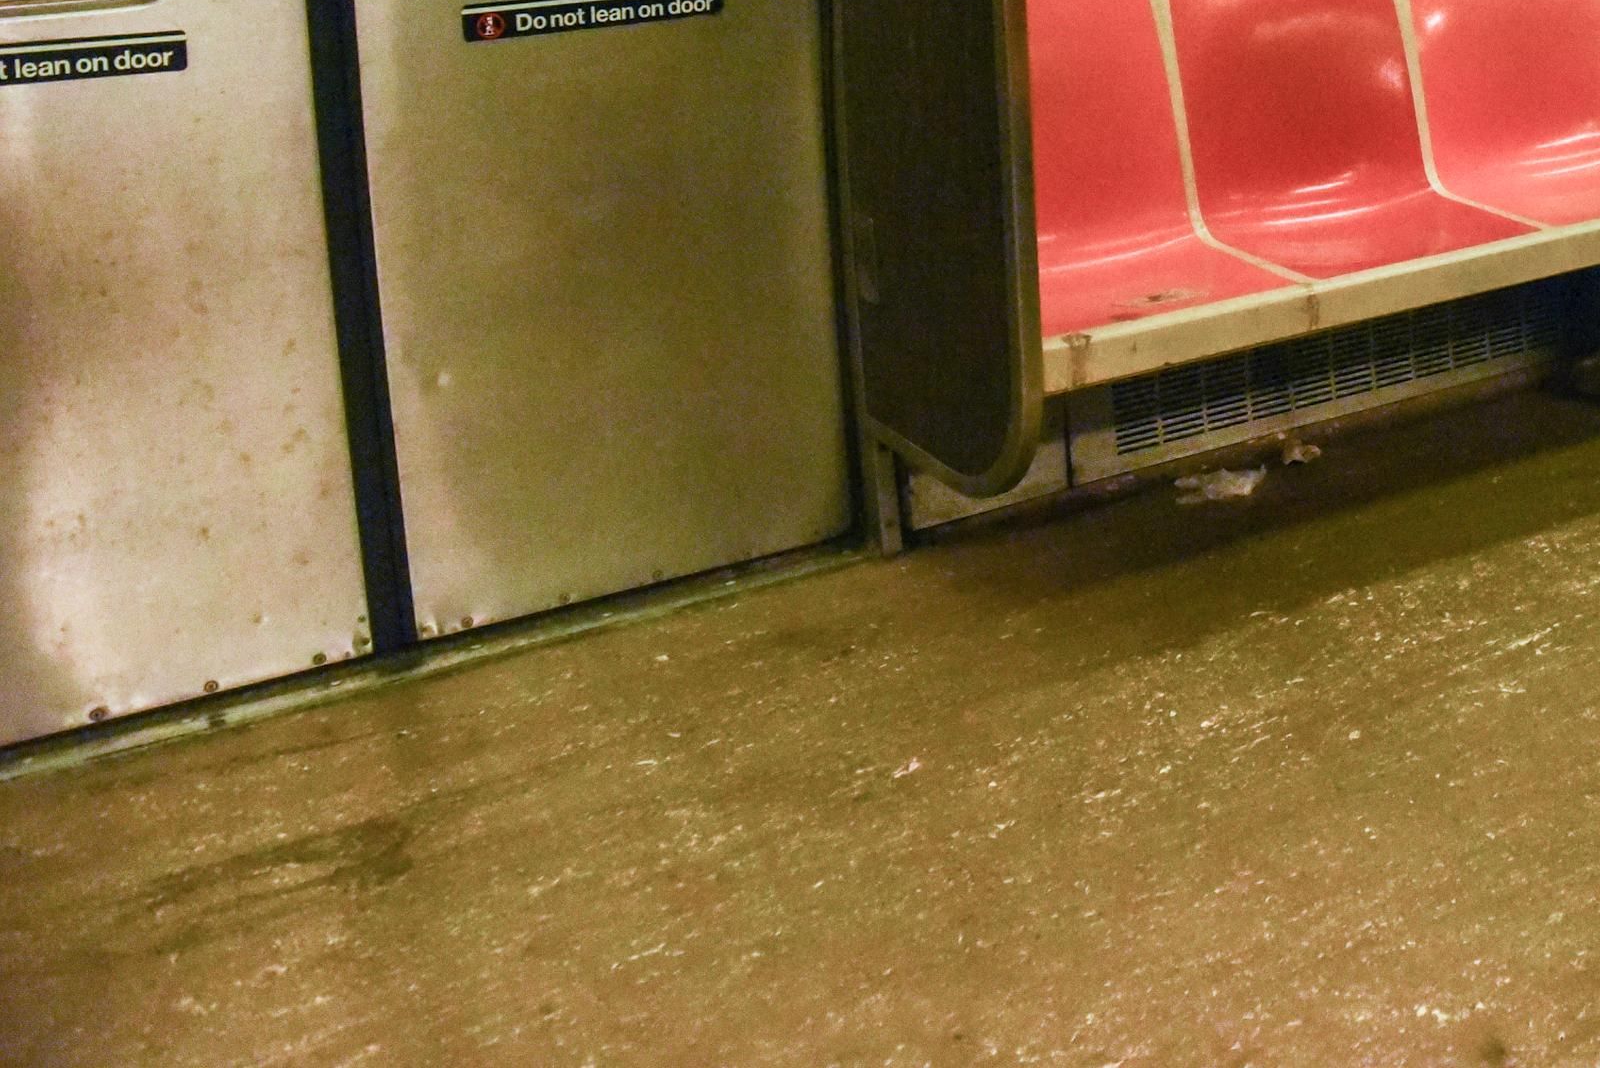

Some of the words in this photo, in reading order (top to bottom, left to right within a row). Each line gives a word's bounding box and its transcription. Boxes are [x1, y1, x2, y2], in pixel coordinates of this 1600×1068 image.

[514, 13, 547, 32] Do
[550, 9, 586, 27] not
[590, 5, 634, 24] lean
[638, 2, 664, 19] on
[14, 58, 71, 78] lean
[75, 55, 109, 73] on
[113, 50, 174, 70] door
